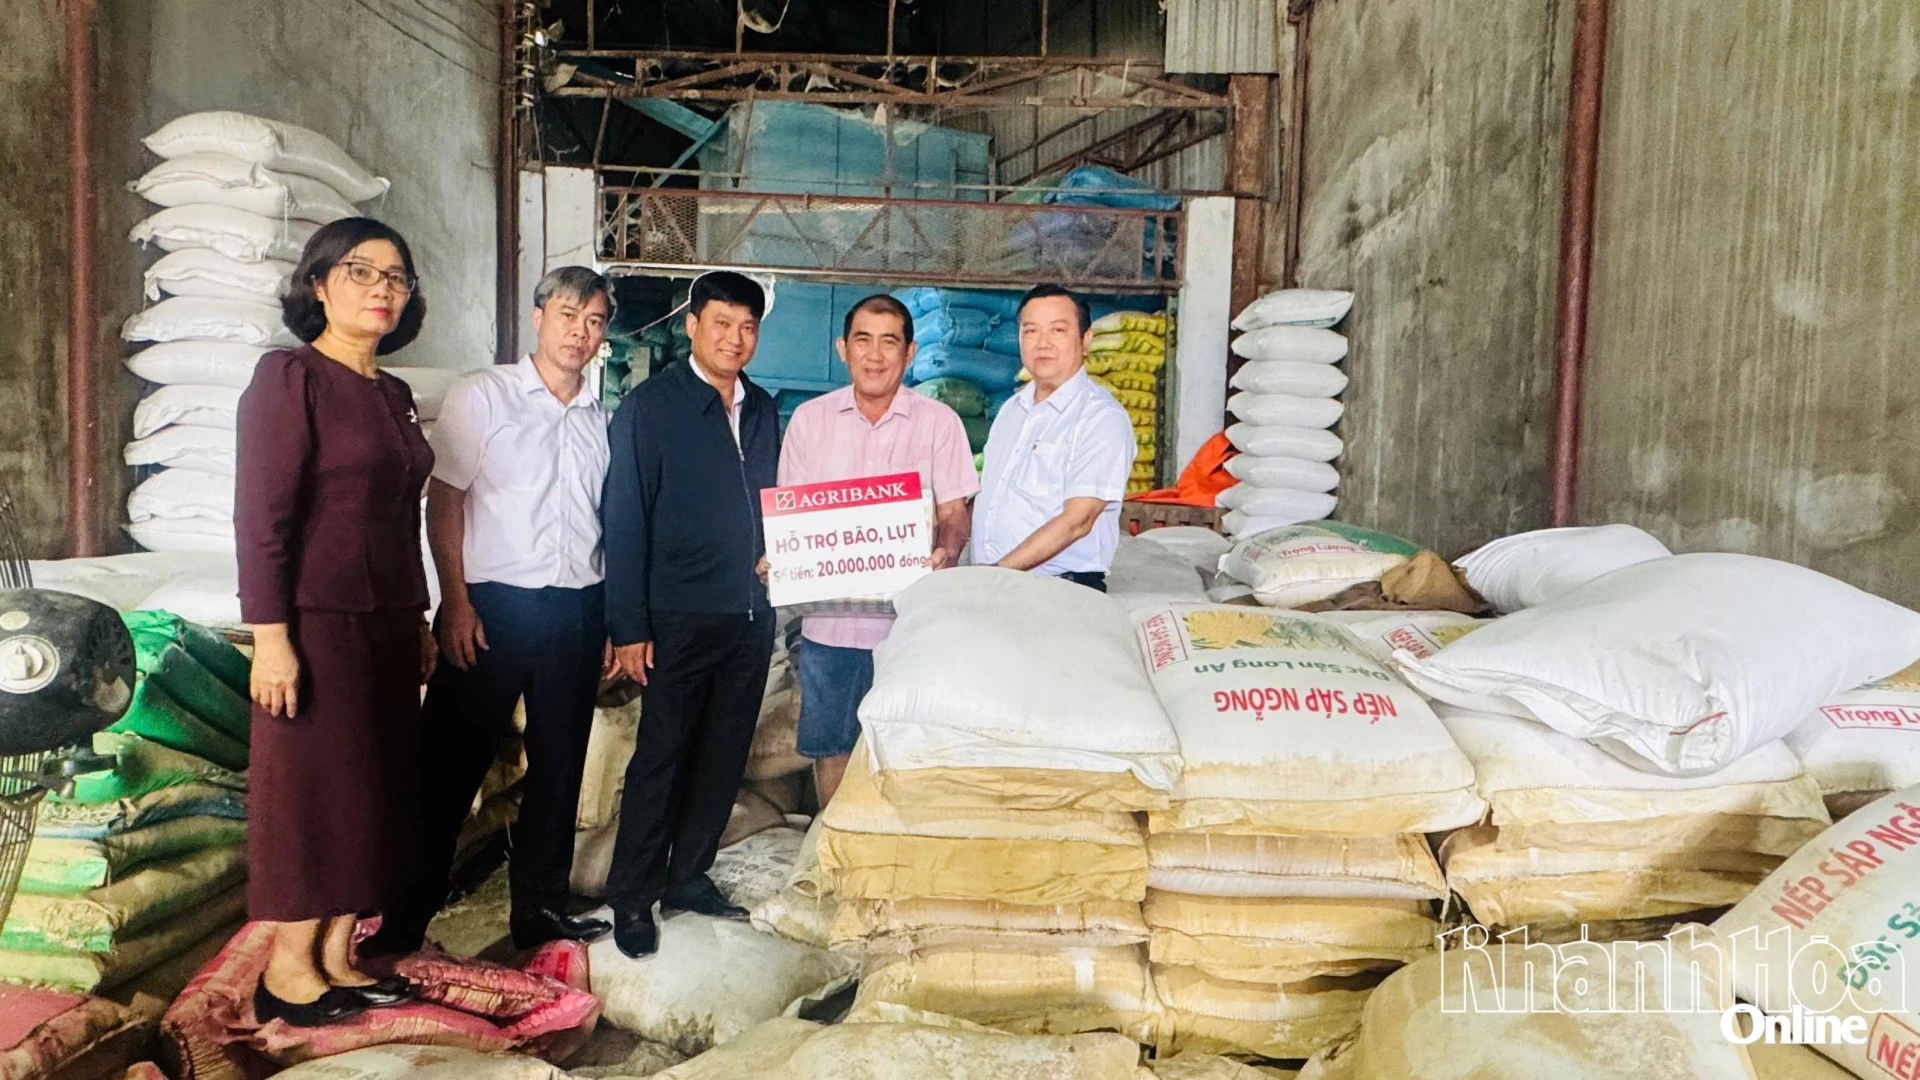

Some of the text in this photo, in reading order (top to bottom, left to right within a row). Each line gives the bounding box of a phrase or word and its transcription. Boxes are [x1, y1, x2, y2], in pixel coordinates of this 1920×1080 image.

[799, 482, 907, 508] AGRIBANK
[775, 523, 917, 554] HỖ TRỢ BÃO, LỤT
[817, 553, 895, 578] 20.000.000
[900, 551, 927, 569] đồng
[1194, 662, 1225, 674] An
[1231, 659, 1293, 672] Long
[1298, 660, 1344, 675] Sản
[1213, 687, 1398, 725] NẾP SÁP NGỖNG
[1827, 707, 1902, 726] Trọng
[1771, 879, 1835, 930] NẾP
[1818, 846, 1885, 888] SÁP
